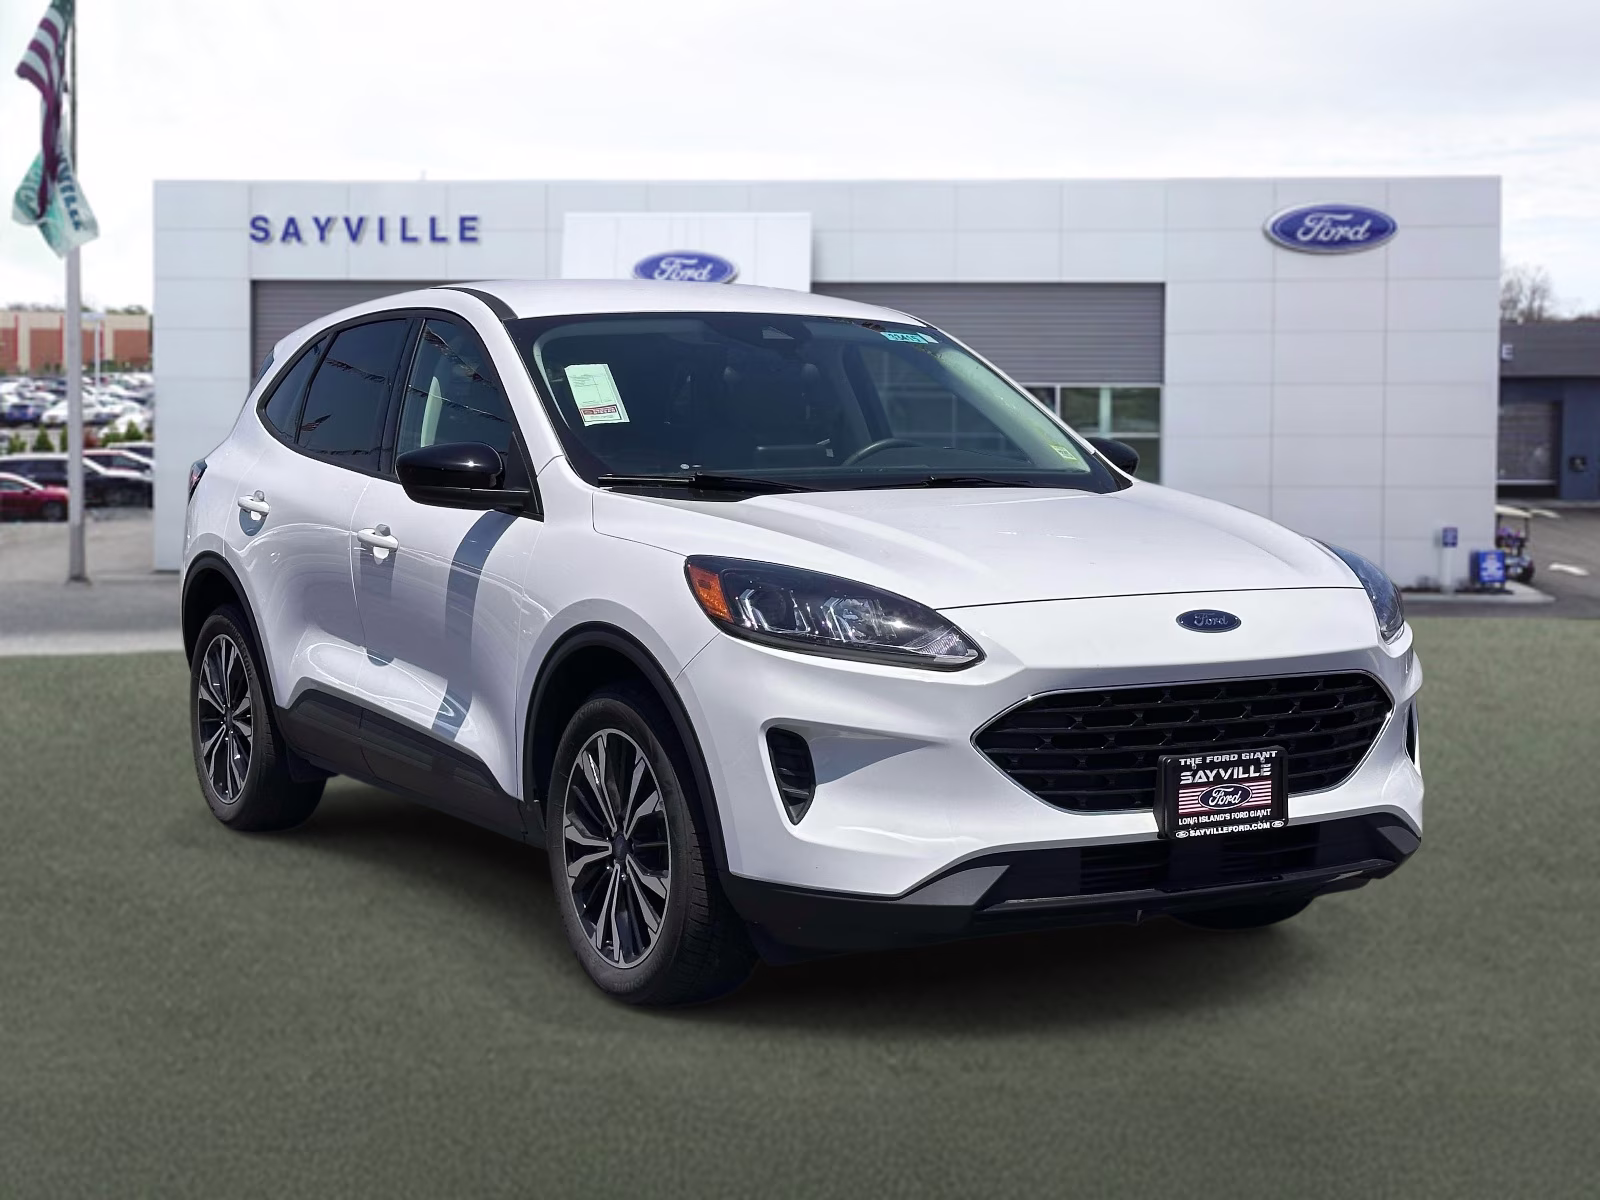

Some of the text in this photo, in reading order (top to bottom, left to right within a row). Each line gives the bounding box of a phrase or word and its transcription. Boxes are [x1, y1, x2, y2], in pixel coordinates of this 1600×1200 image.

[249, 215, 479, 243] SAYVILLE
[1296, 211, 1372, 241] Ford
[654, 256, 714, 281] Ford
[1179, 750, 1278, 766] THE FORD GIANT
[1179, 763, 1272, 785] SAYVILLE
[1208, 787, 1242, 806] Ford
[1178, 808, 1272, 825] LONG ISLAND'S FORD GIANT
[1189, 821, 1270, 837] SAYVILLEFORD.COM
